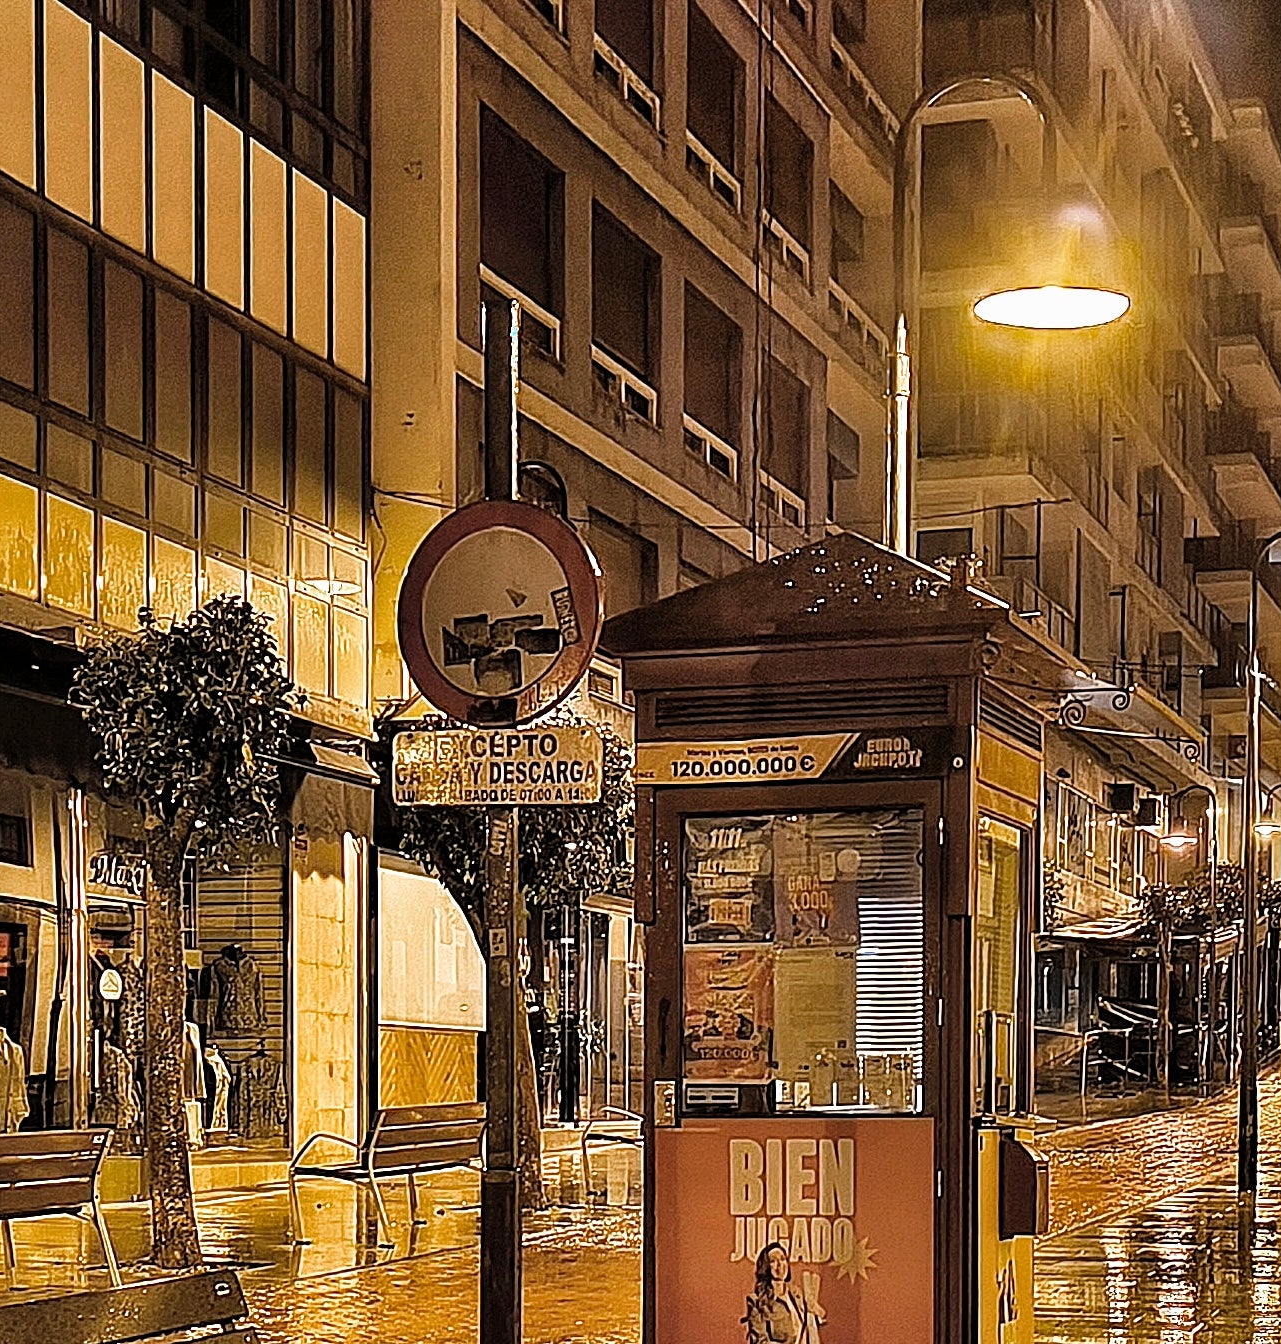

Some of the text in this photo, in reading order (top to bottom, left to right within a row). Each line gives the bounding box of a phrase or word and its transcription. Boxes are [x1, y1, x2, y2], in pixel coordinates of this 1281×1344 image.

[470, 762, 483, 785] Y
[490, 760, 596, 785] DESCARGA
[501, 788, 516, 801] DE
[555, 787, 564, 800] A
[729, 1138, 855, 1216] BIEN
[730, 1217, 854, 1264] JUGADO
